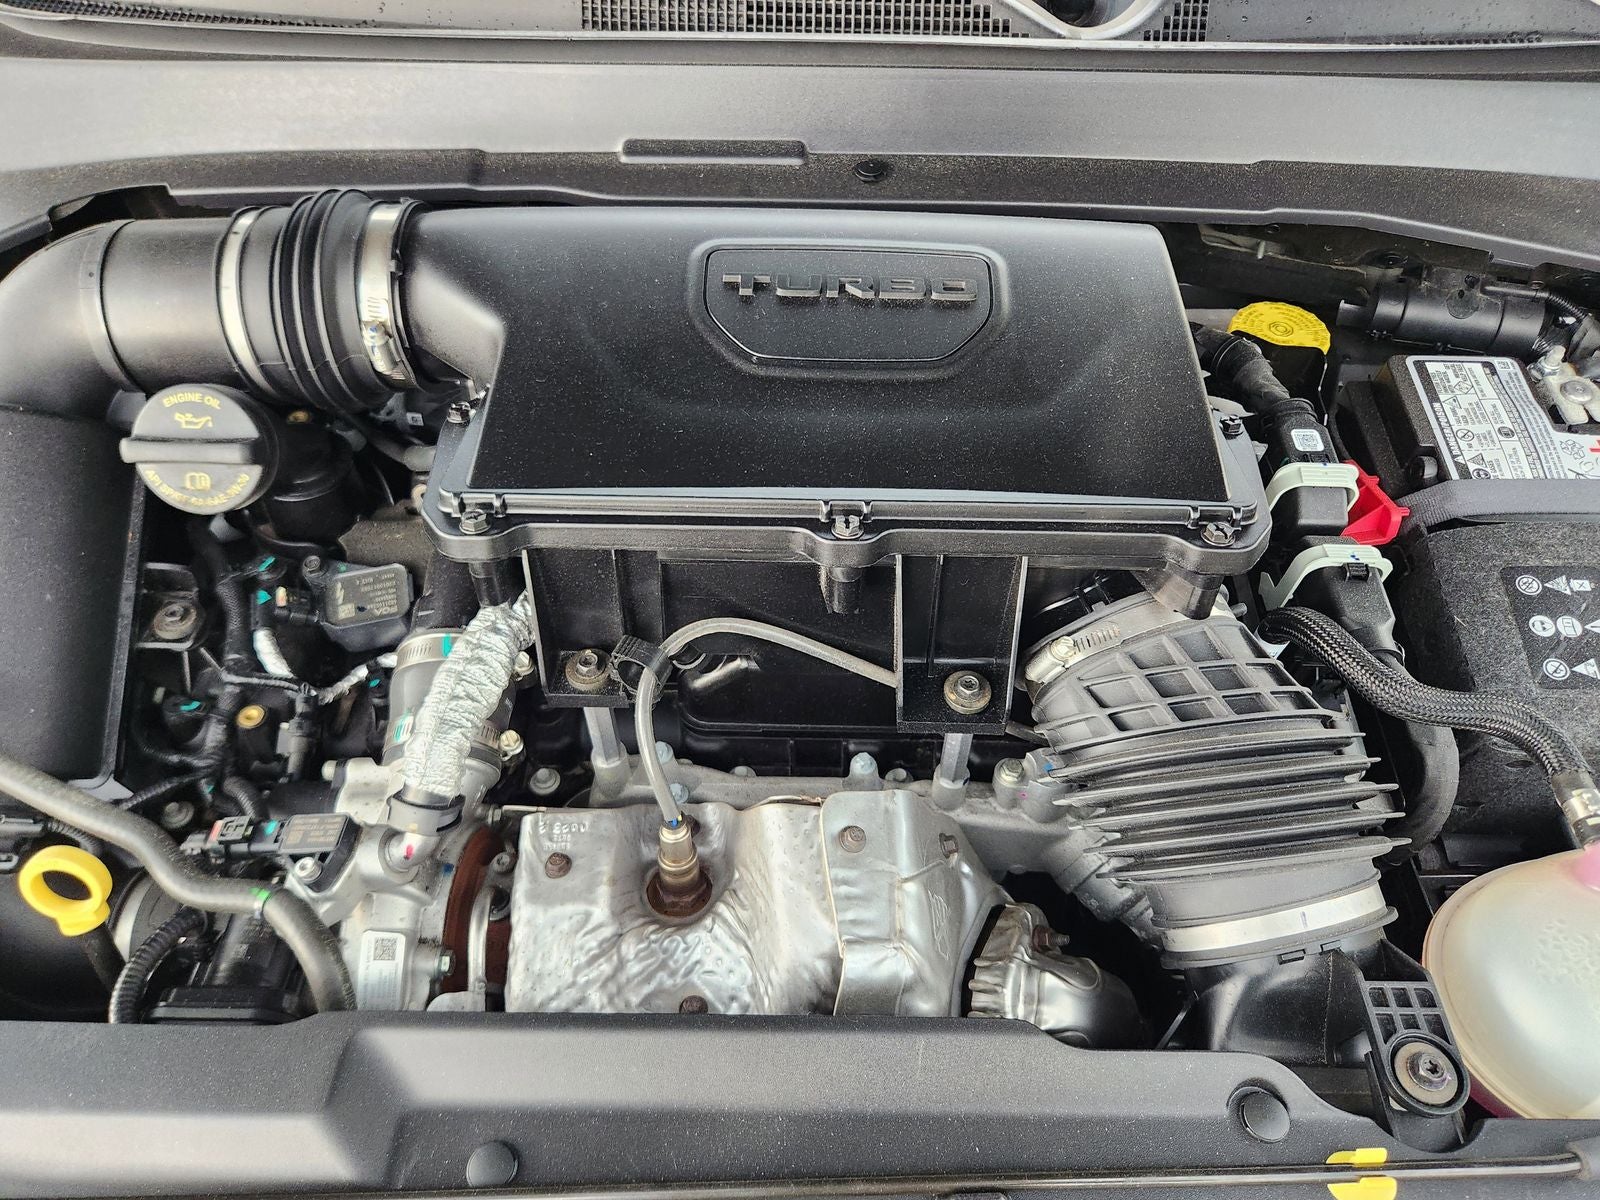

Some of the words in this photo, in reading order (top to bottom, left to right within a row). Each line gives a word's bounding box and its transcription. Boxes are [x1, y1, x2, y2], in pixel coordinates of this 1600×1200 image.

[722, 273, 977, 301] TURBO
[162, 392, 203, 408] ENGINE
[204, 395, 222, 410] OIL
